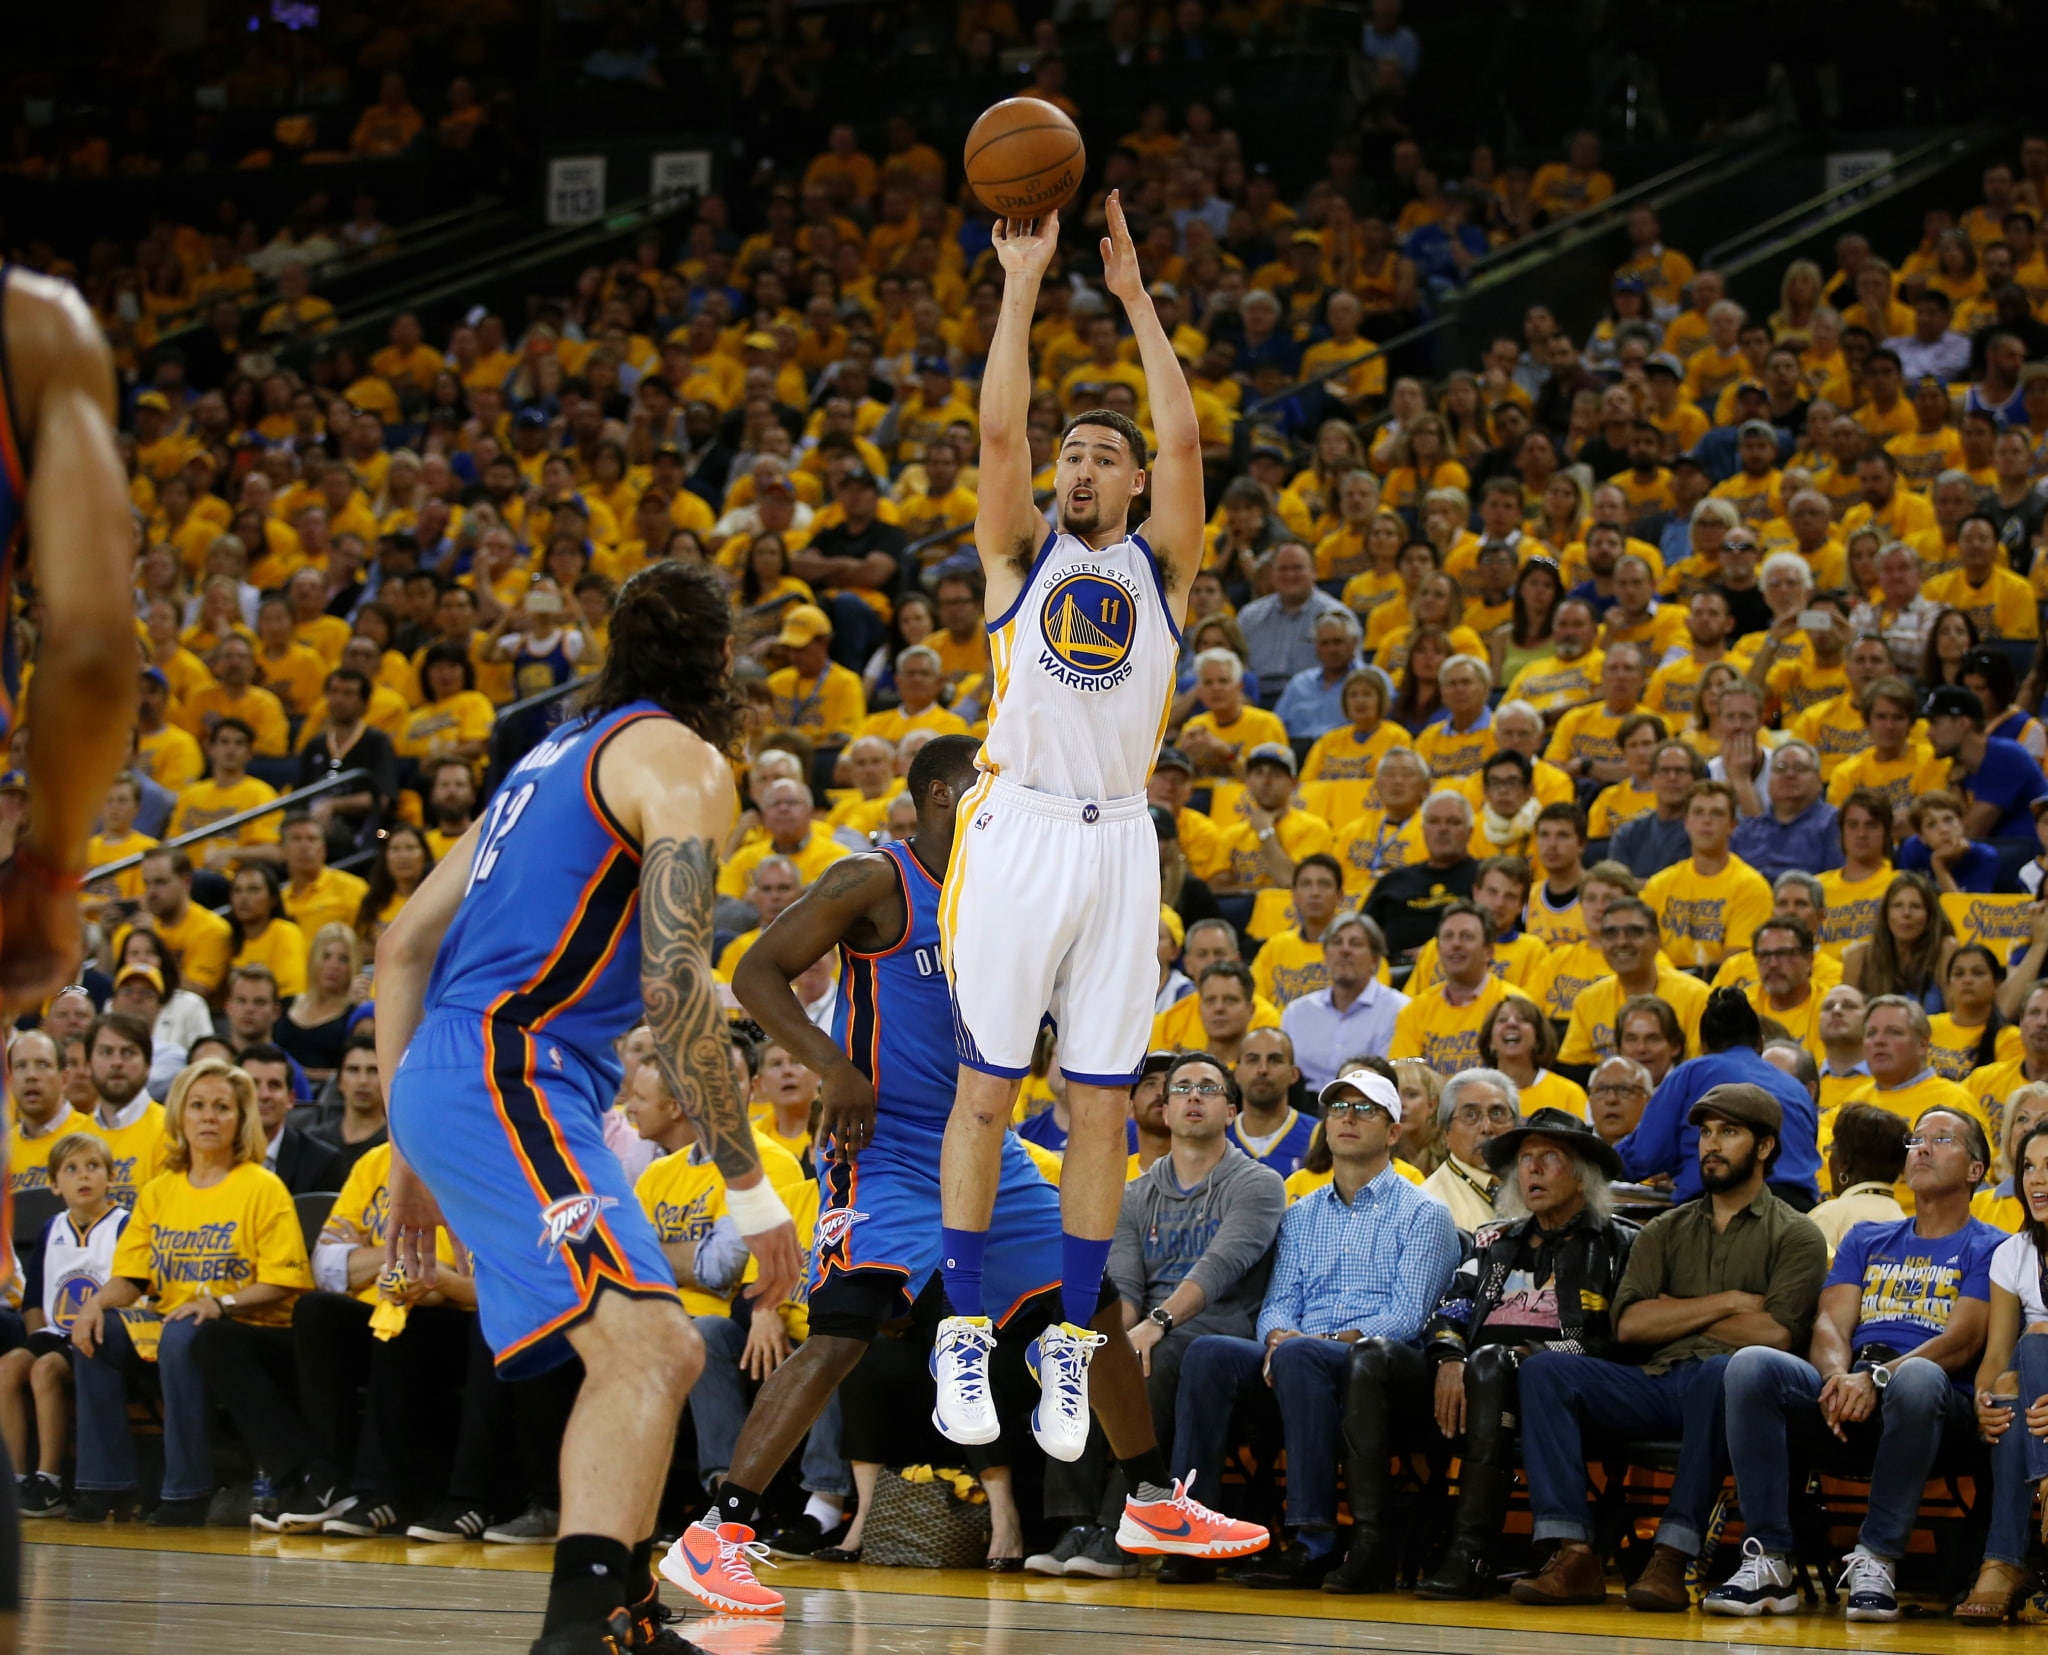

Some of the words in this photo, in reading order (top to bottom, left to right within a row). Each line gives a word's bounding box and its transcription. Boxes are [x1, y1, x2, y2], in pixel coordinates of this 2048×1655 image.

[995, 169, 1074, 209] SPALDING
[1043, 563, 1101, 590] GOLDEN
[1105, 569, 1142, 603] STATE
[1100, 597, 1121, 625] 11
[1038, 649, 1133, 692] WARRIORS
[1084, 808, 1098, 819] W
[464, 781, 536, 898] 12
[551, 1199, 589, 1244] OKC
[819, 1214, 847, 1245] OKC
[149, 1221, 237, 1270] Strength
